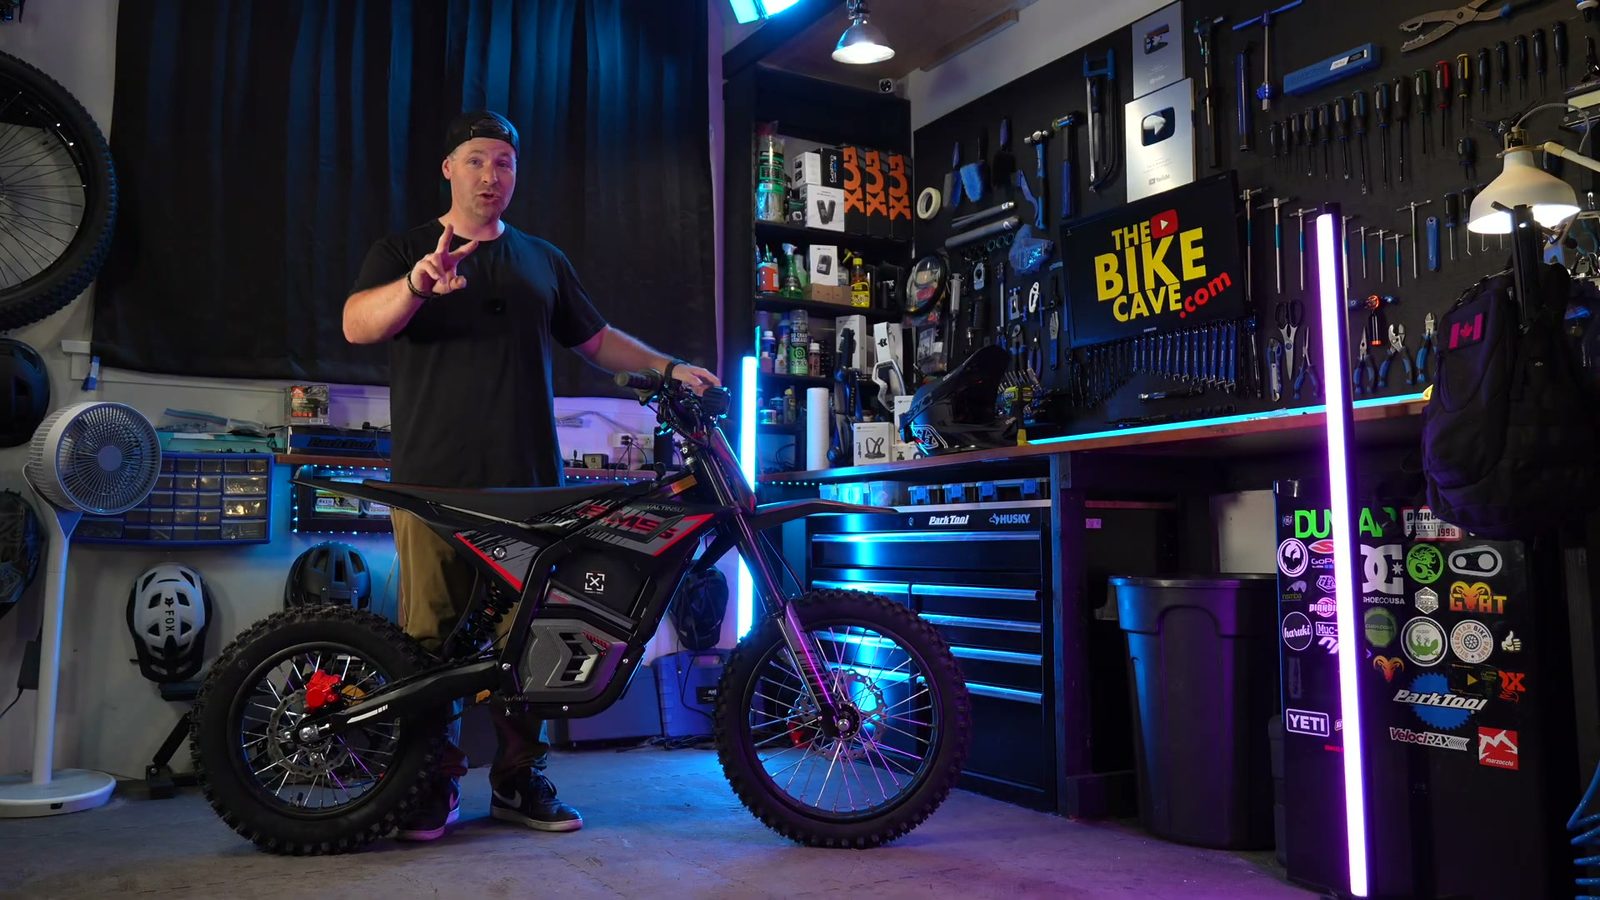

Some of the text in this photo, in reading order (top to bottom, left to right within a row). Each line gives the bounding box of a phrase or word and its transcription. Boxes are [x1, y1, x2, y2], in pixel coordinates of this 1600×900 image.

[1111, 220, 1151, 250] THE
[1094, 227, 1206, 301] BIKE
[1112, 282, 1182, 322] CAVE
[1000, 514, 1030, 524] HUSKY
[165, 610, 175, 631] FOX
[1289, 714, 1326, 732] YETI
